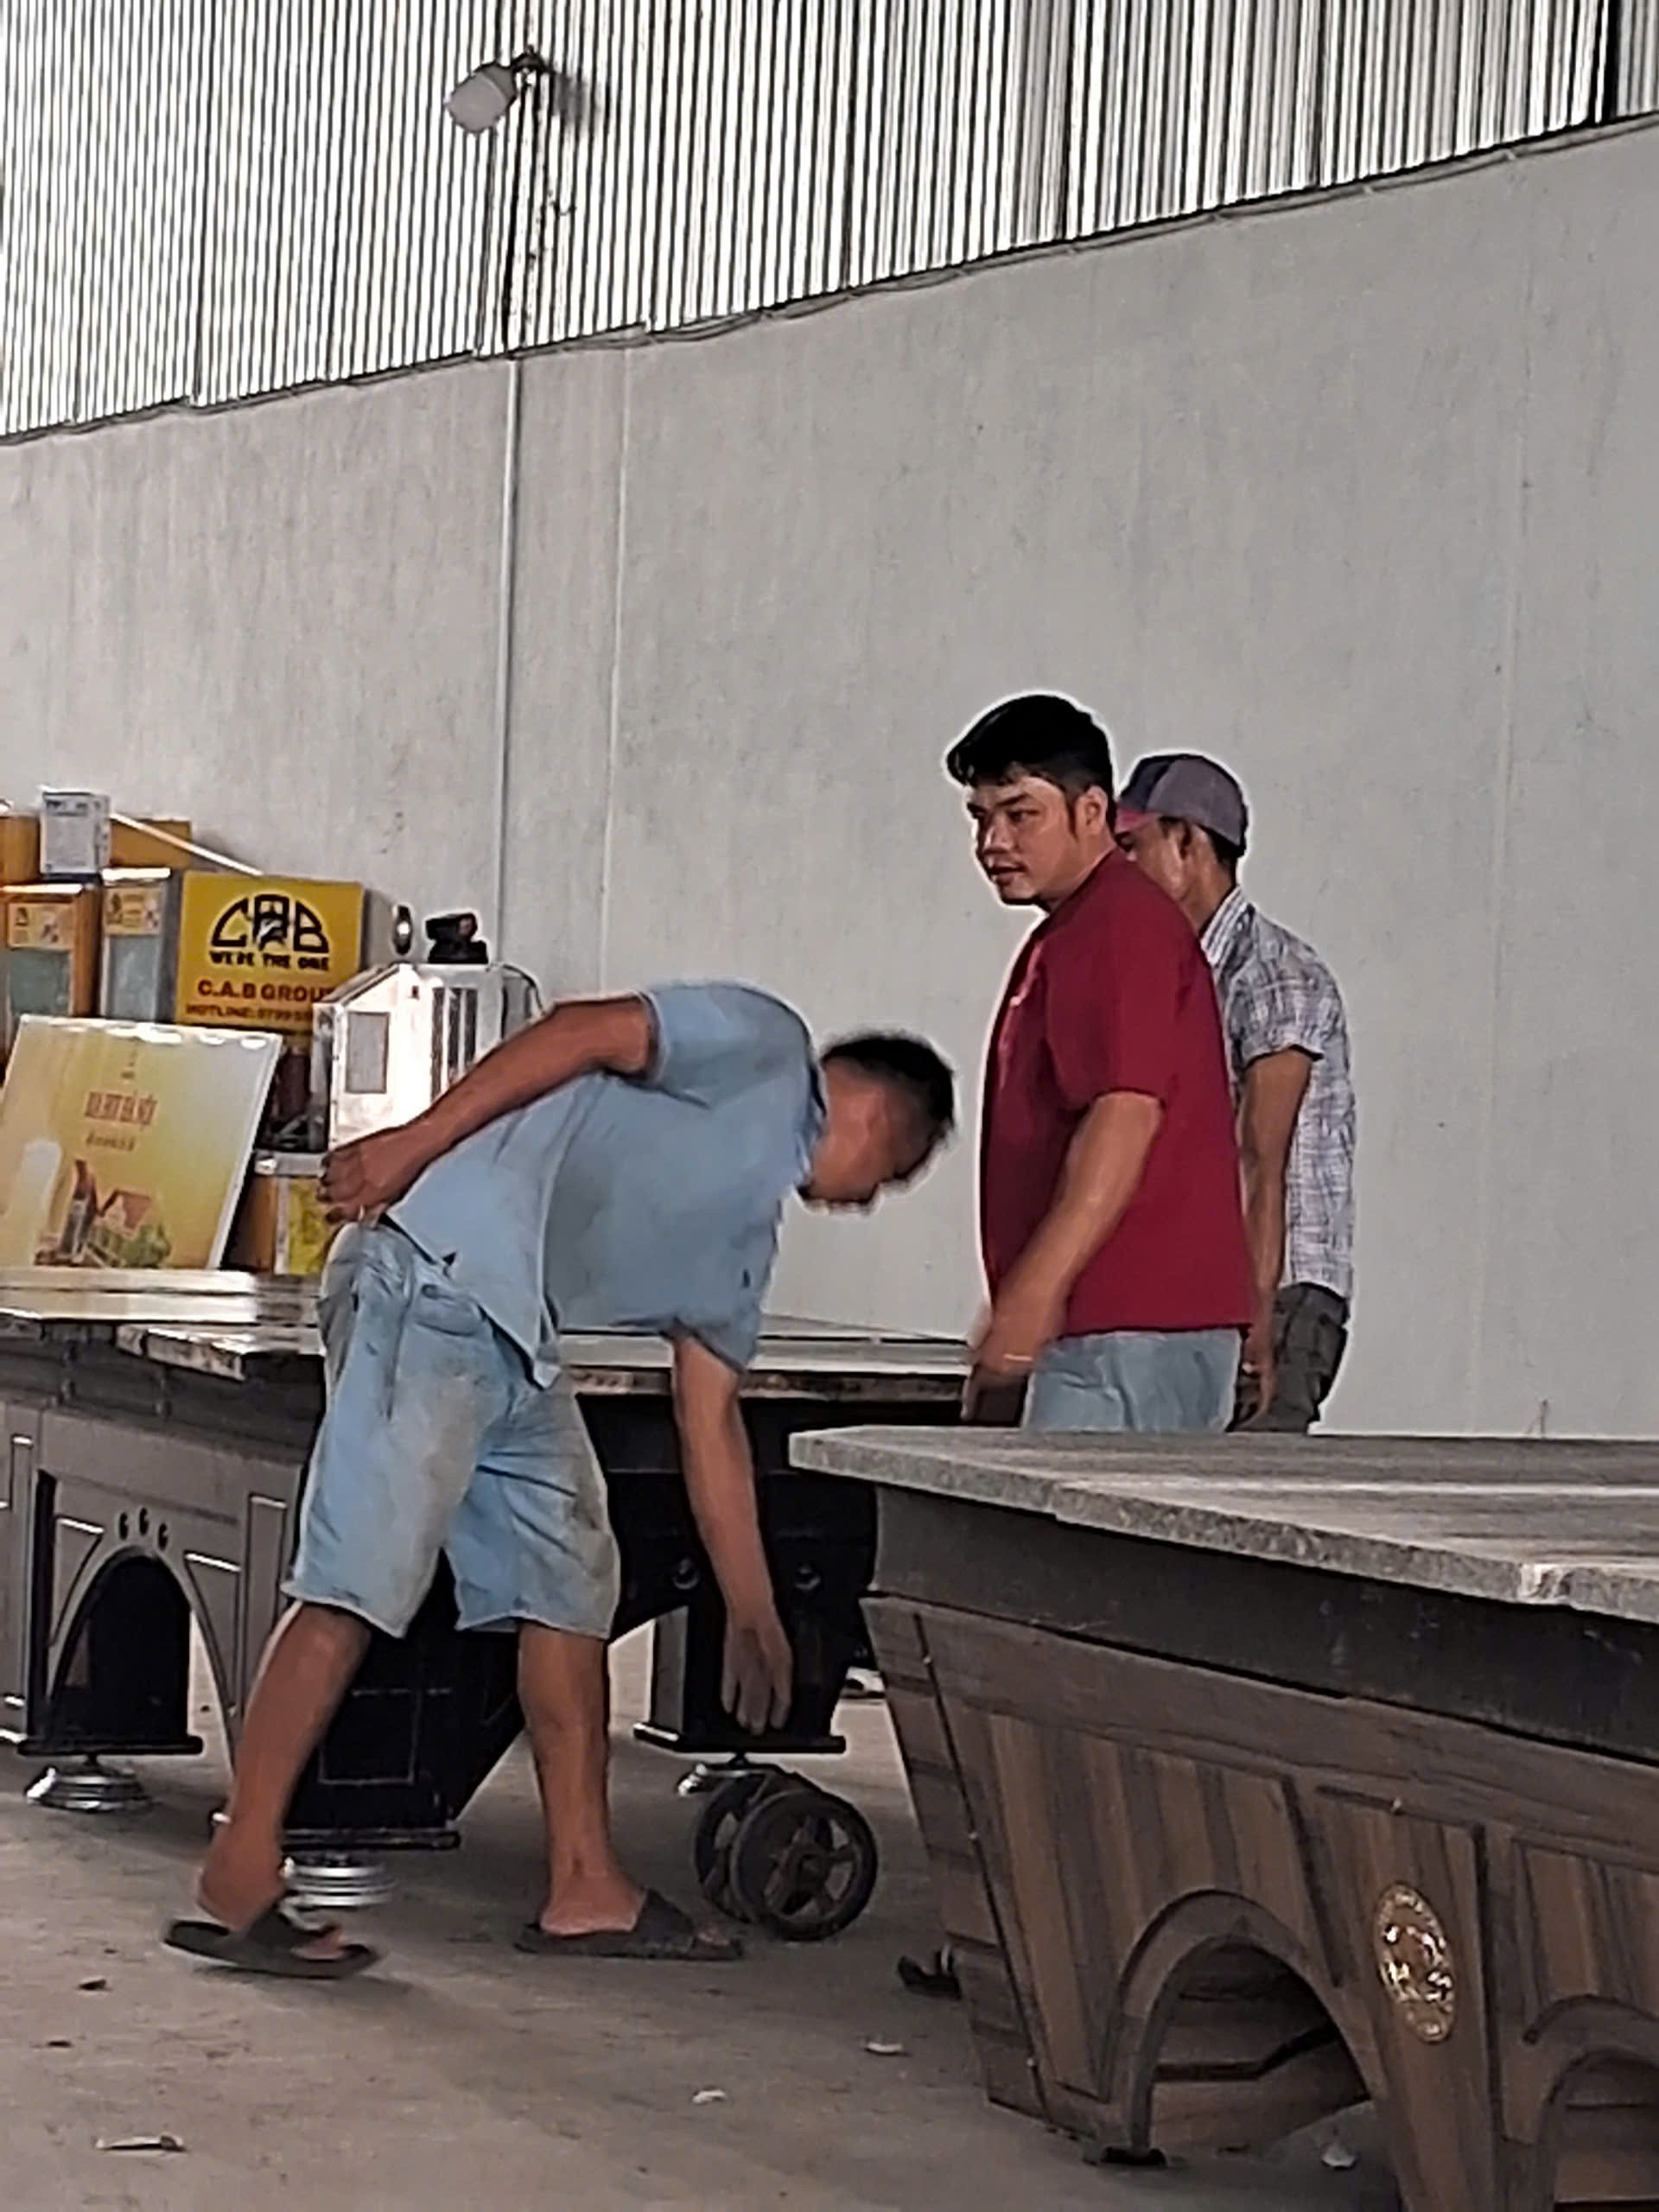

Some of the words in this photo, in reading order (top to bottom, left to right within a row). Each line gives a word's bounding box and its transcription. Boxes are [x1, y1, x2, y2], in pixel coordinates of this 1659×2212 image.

[212, 893, 329, 954] CAB
[263, 952, 290, 969] THE
[297, 957, 330, 972] ONE
[198, 979, 257, 1000] C.A.B
